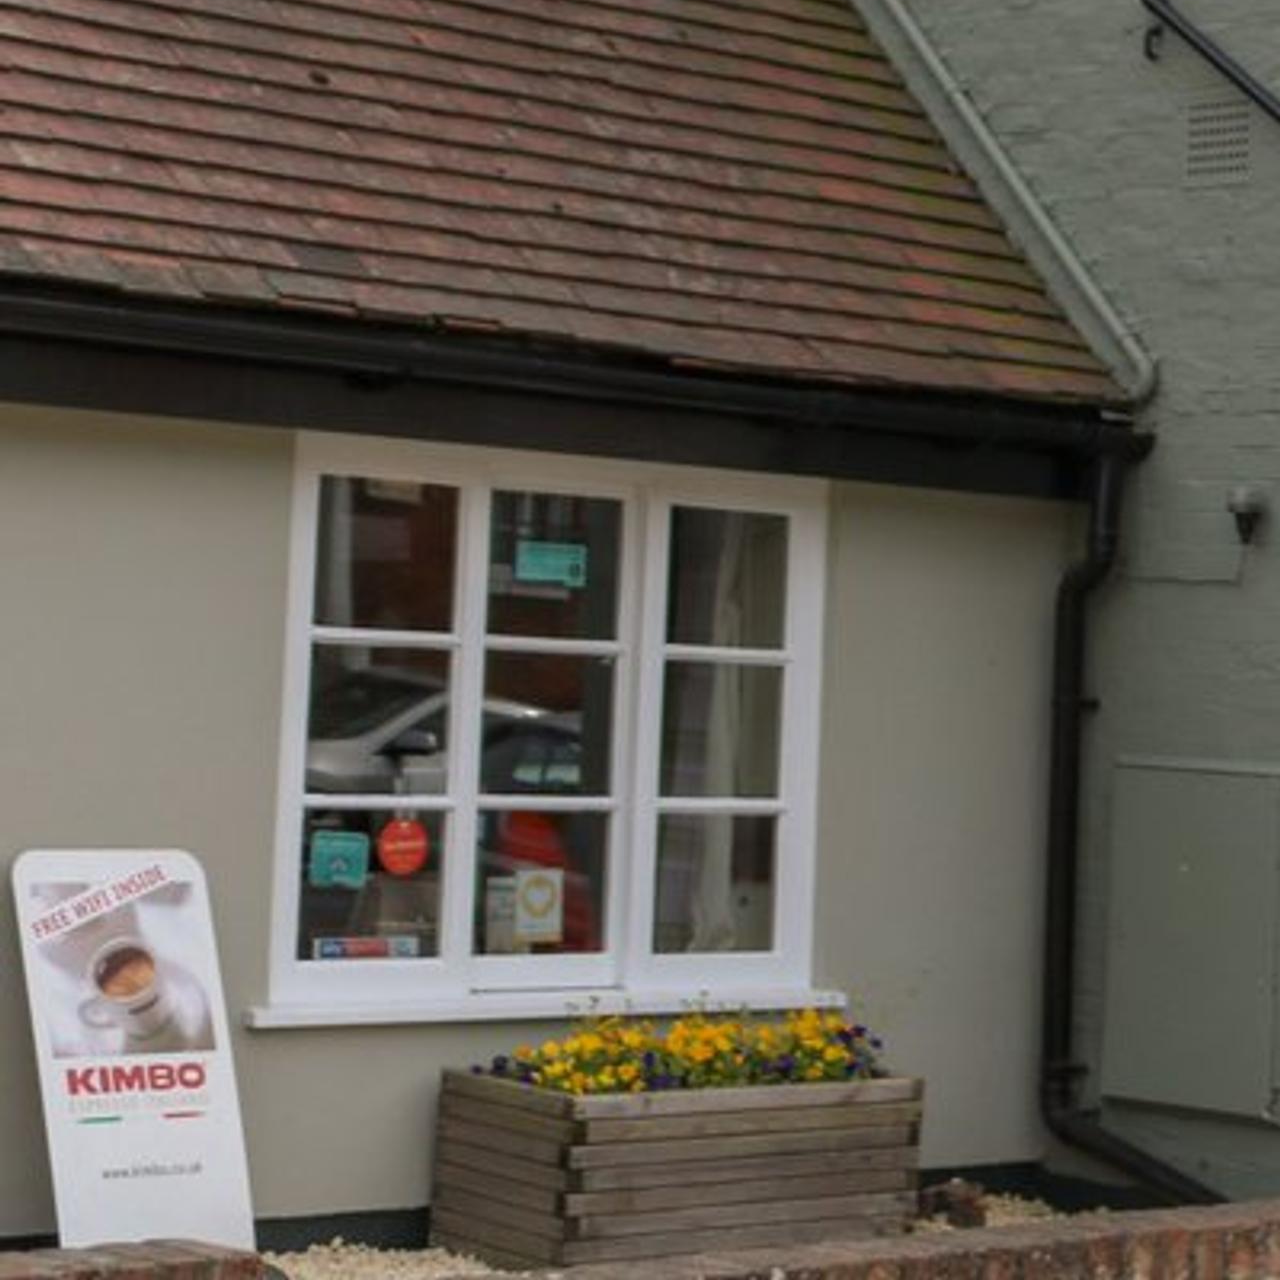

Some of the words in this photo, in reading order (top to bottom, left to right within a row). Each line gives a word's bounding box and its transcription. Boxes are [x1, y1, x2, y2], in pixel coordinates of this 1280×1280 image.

[31, 908, 72, 939] FREE
[111, 863, 167, 901] INSIDE
[66, 1062, 206, 1095] KIMBO
